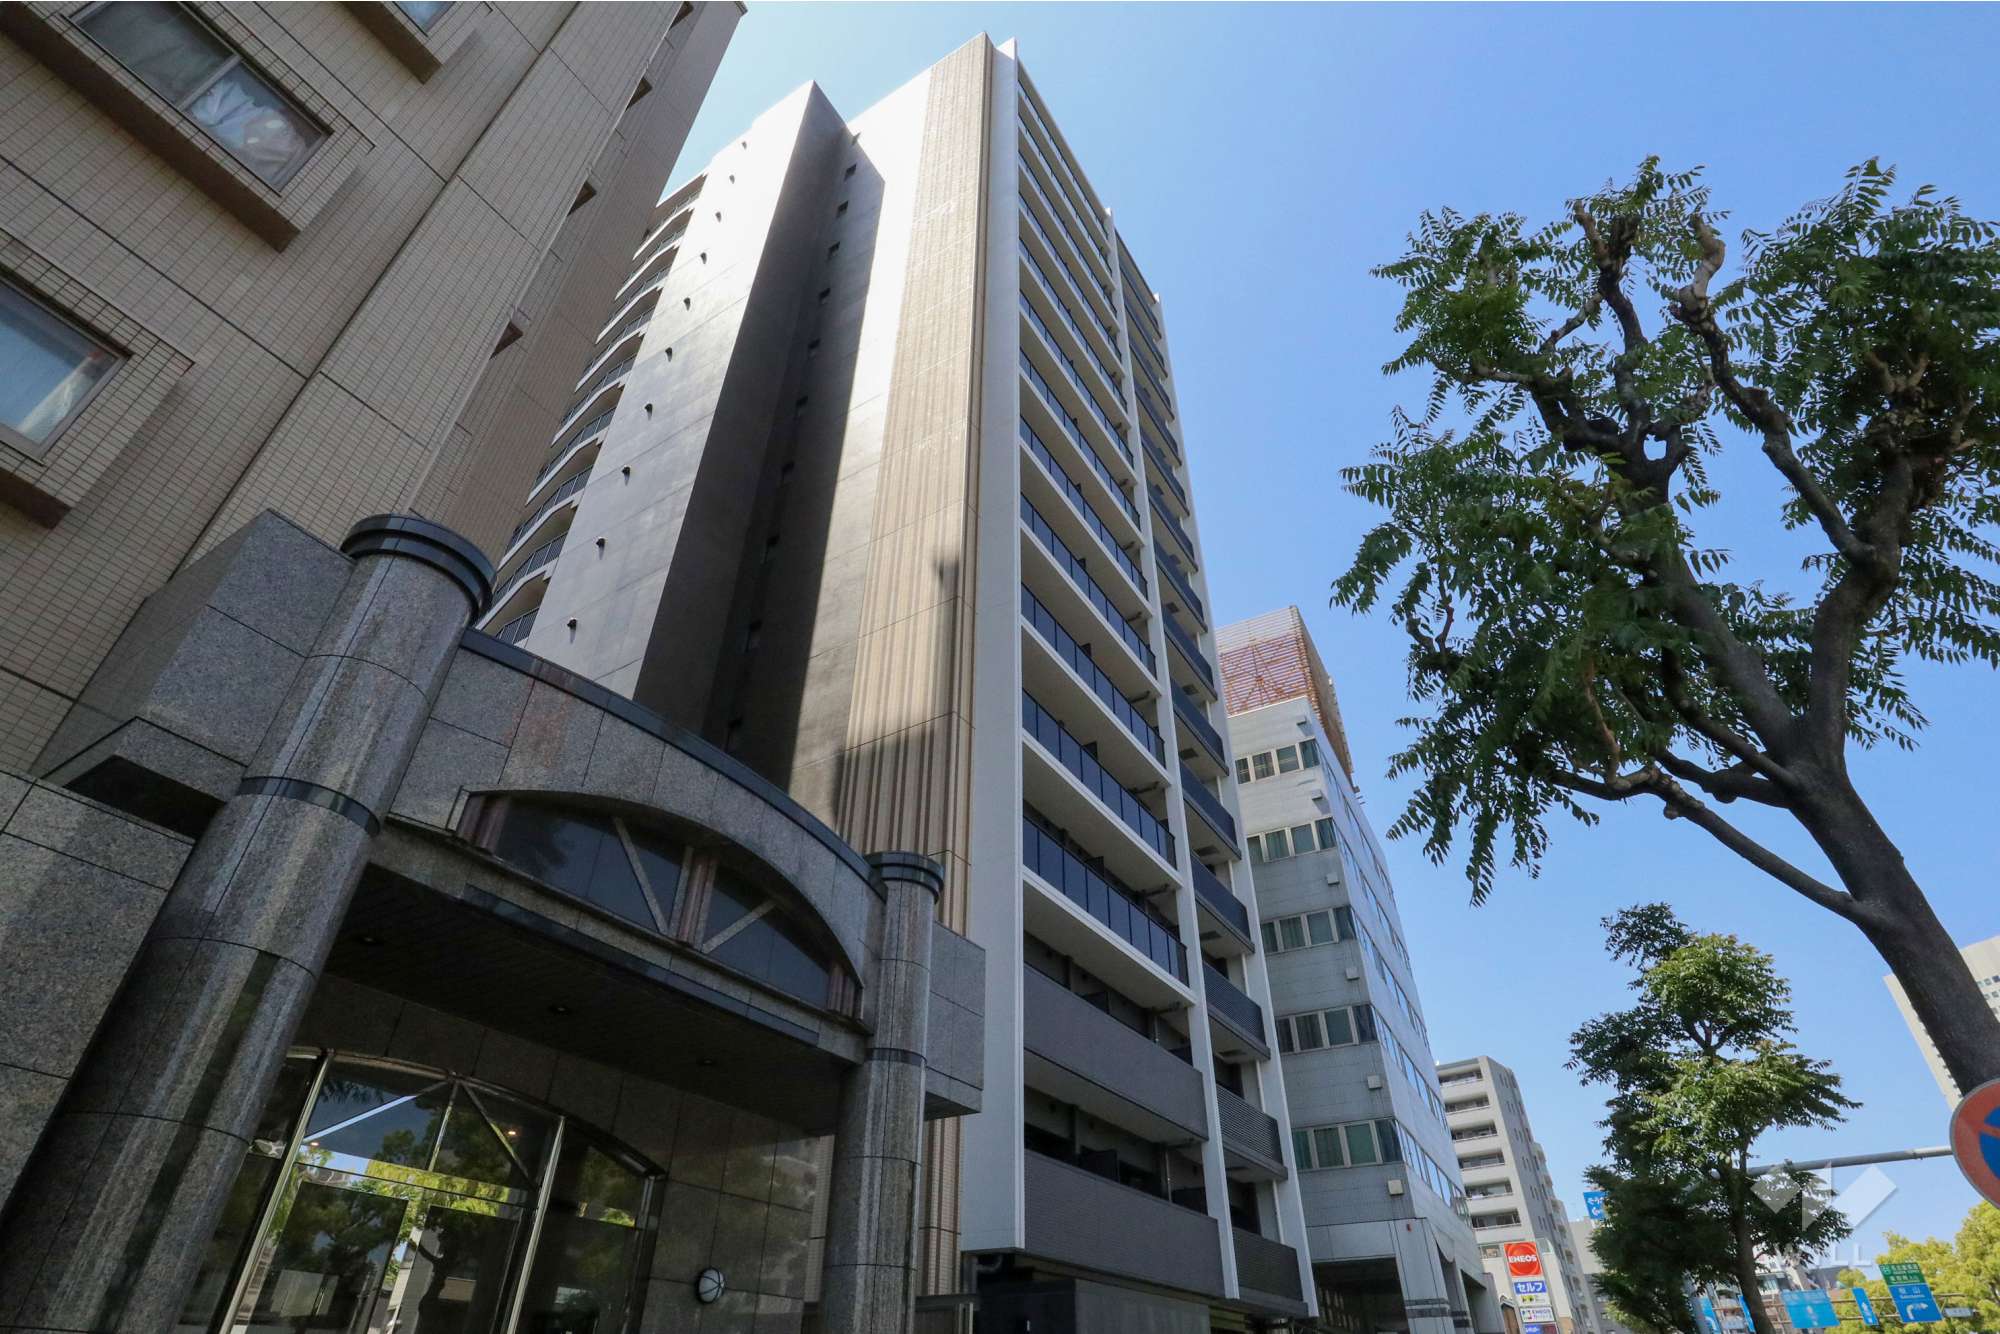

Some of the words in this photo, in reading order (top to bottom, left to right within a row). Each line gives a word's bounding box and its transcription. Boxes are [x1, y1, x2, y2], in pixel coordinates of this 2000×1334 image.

[1508, 1255, 1537, 1264] ENEOS
[1516, 1282, 1543, 1293] セルフ
